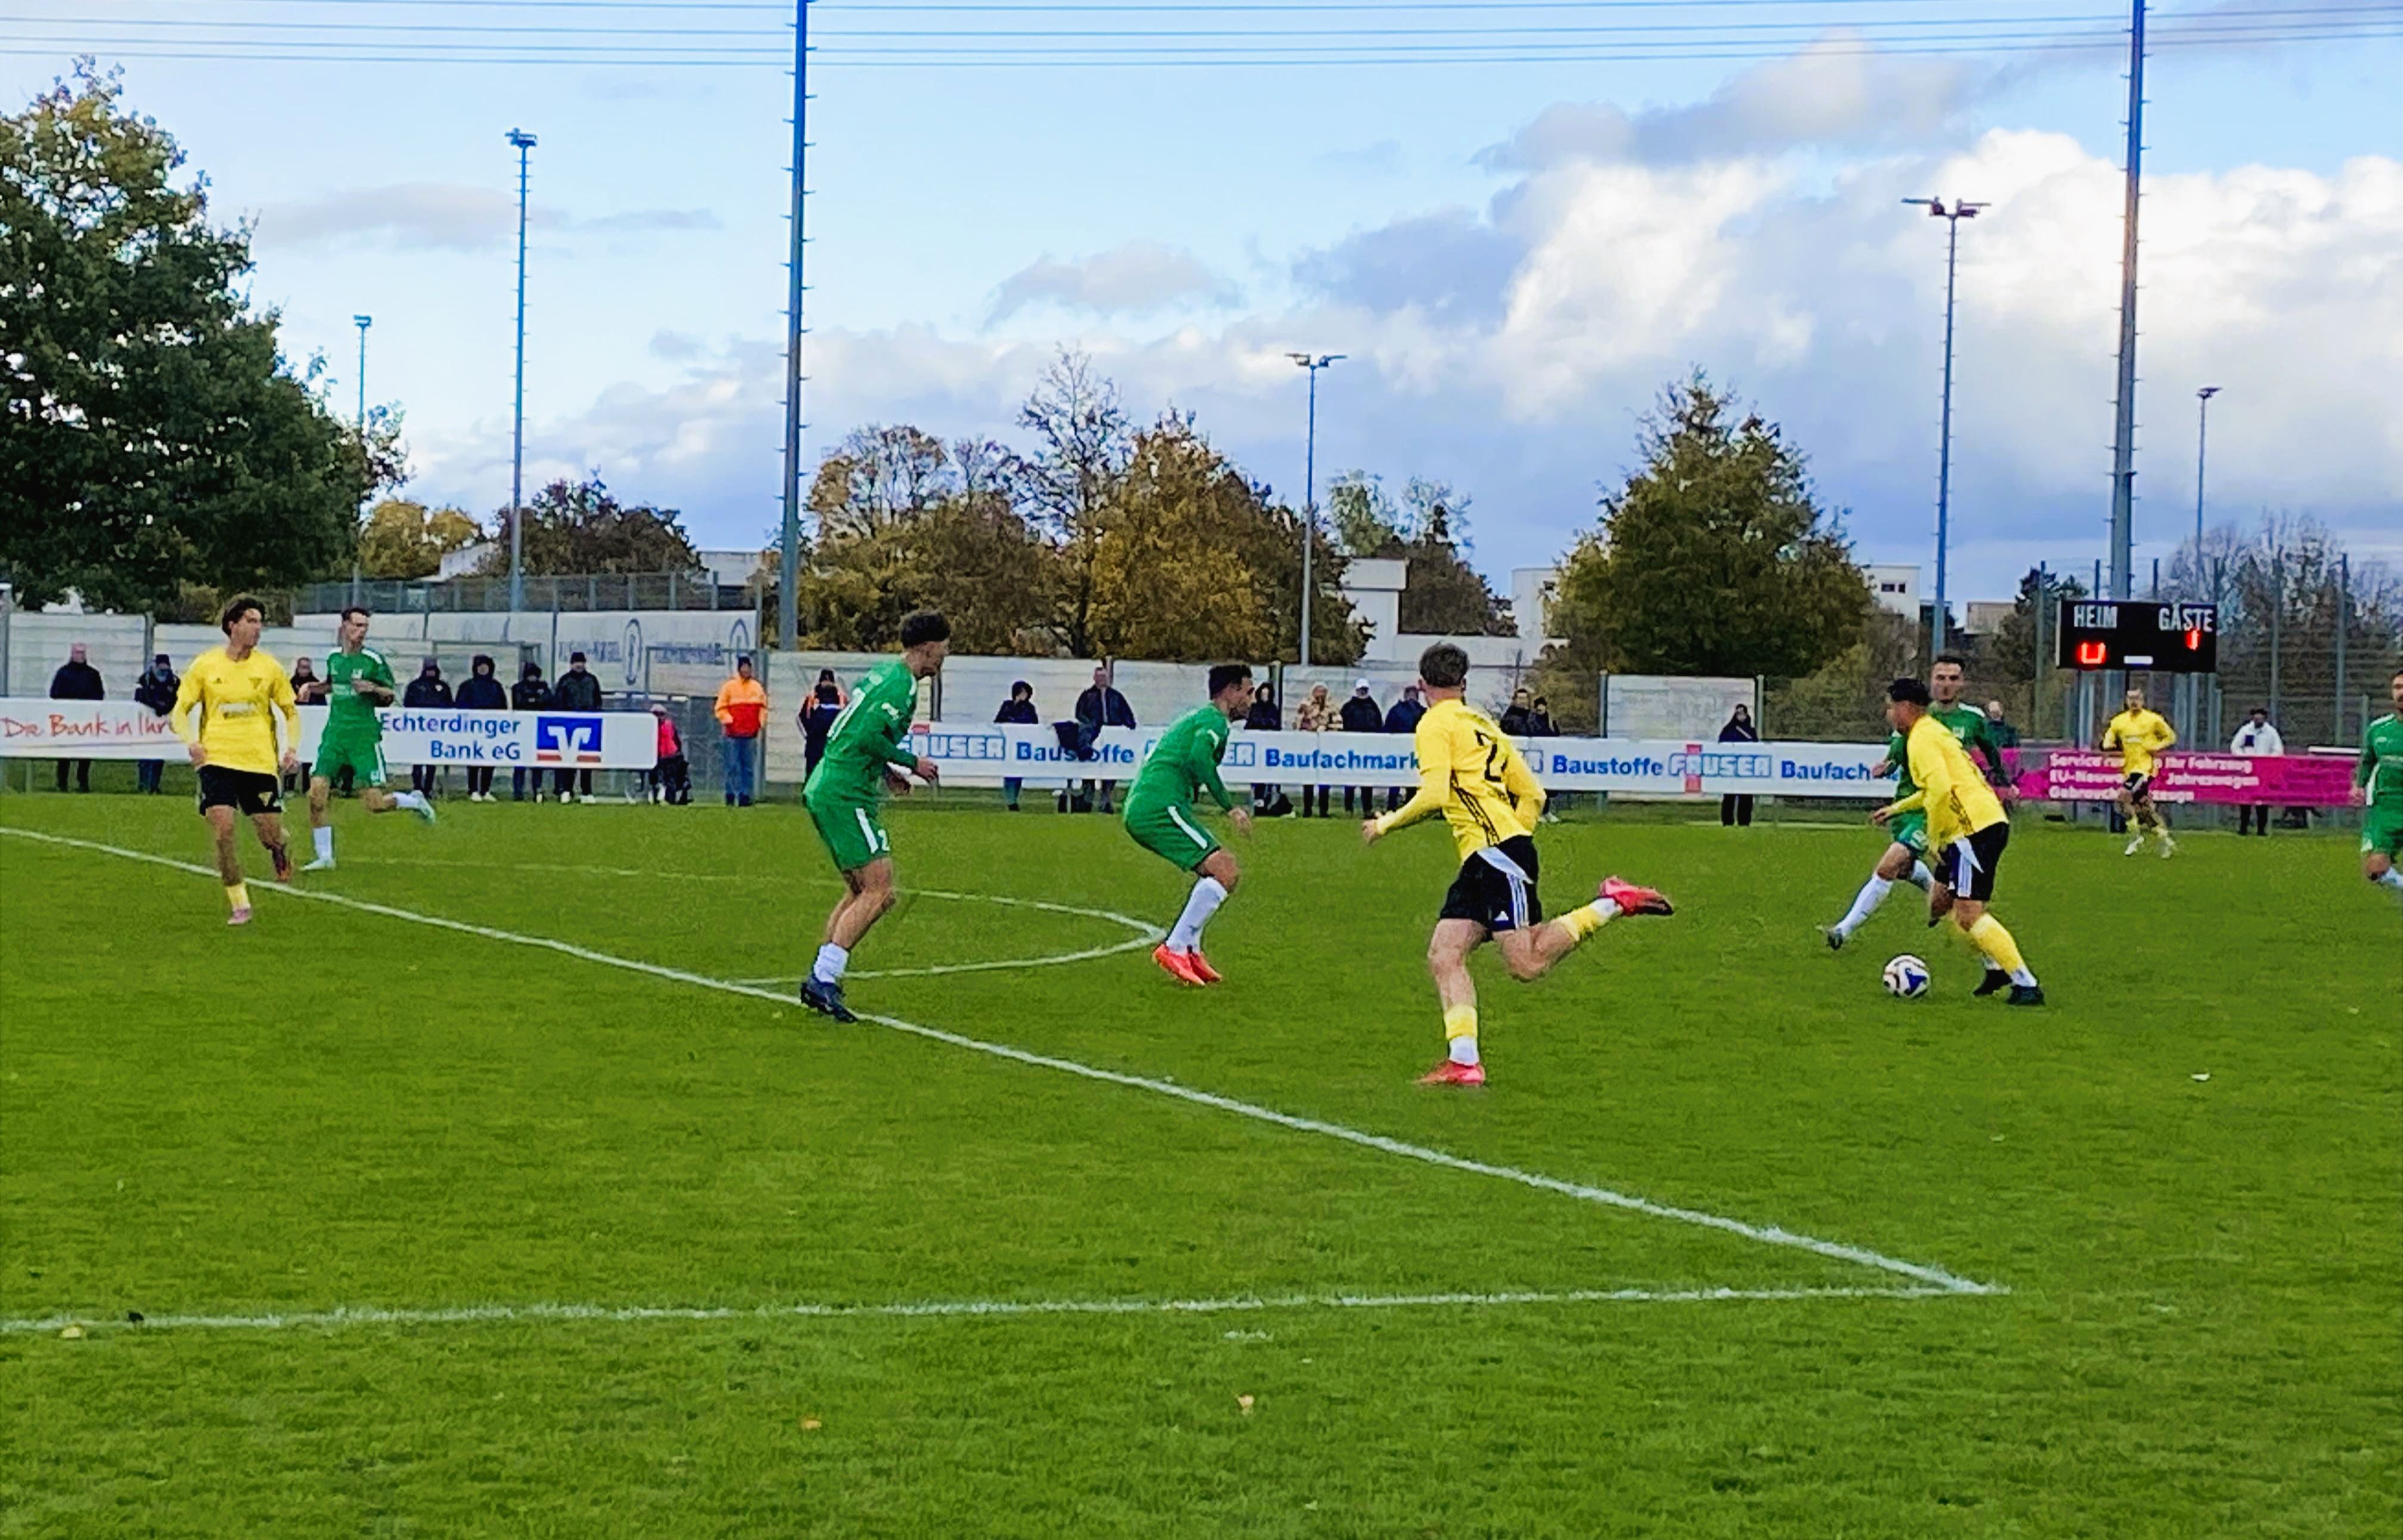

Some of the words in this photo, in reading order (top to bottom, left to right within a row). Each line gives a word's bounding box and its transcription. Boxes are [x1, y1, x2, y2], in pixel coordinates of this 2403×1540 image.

[2074, 604, 2118, 628] HEIM
[2159, 603, 2213, 632] GÄSTE
[49, 712, 110, 738] Bank
[116, 717, 132, 735] in
[138, 710, 175, 735] Ihr
[381, 713, 520, 738] Echterdinger
[430, 741, 484, 759] Bank
[492, 743, 520, 760] eG
[1016, 742, 1134, 763] Bausoffe
[1265, 749, 1418, 769] Baufachmark
[1552, 755, 1663, 776] Baustoffe
[1669, 753, 1772, 777] FAUSER
[2050, 753, 2102, 767] Service
[2188, 756, 2253, 774] Fahrzeug
